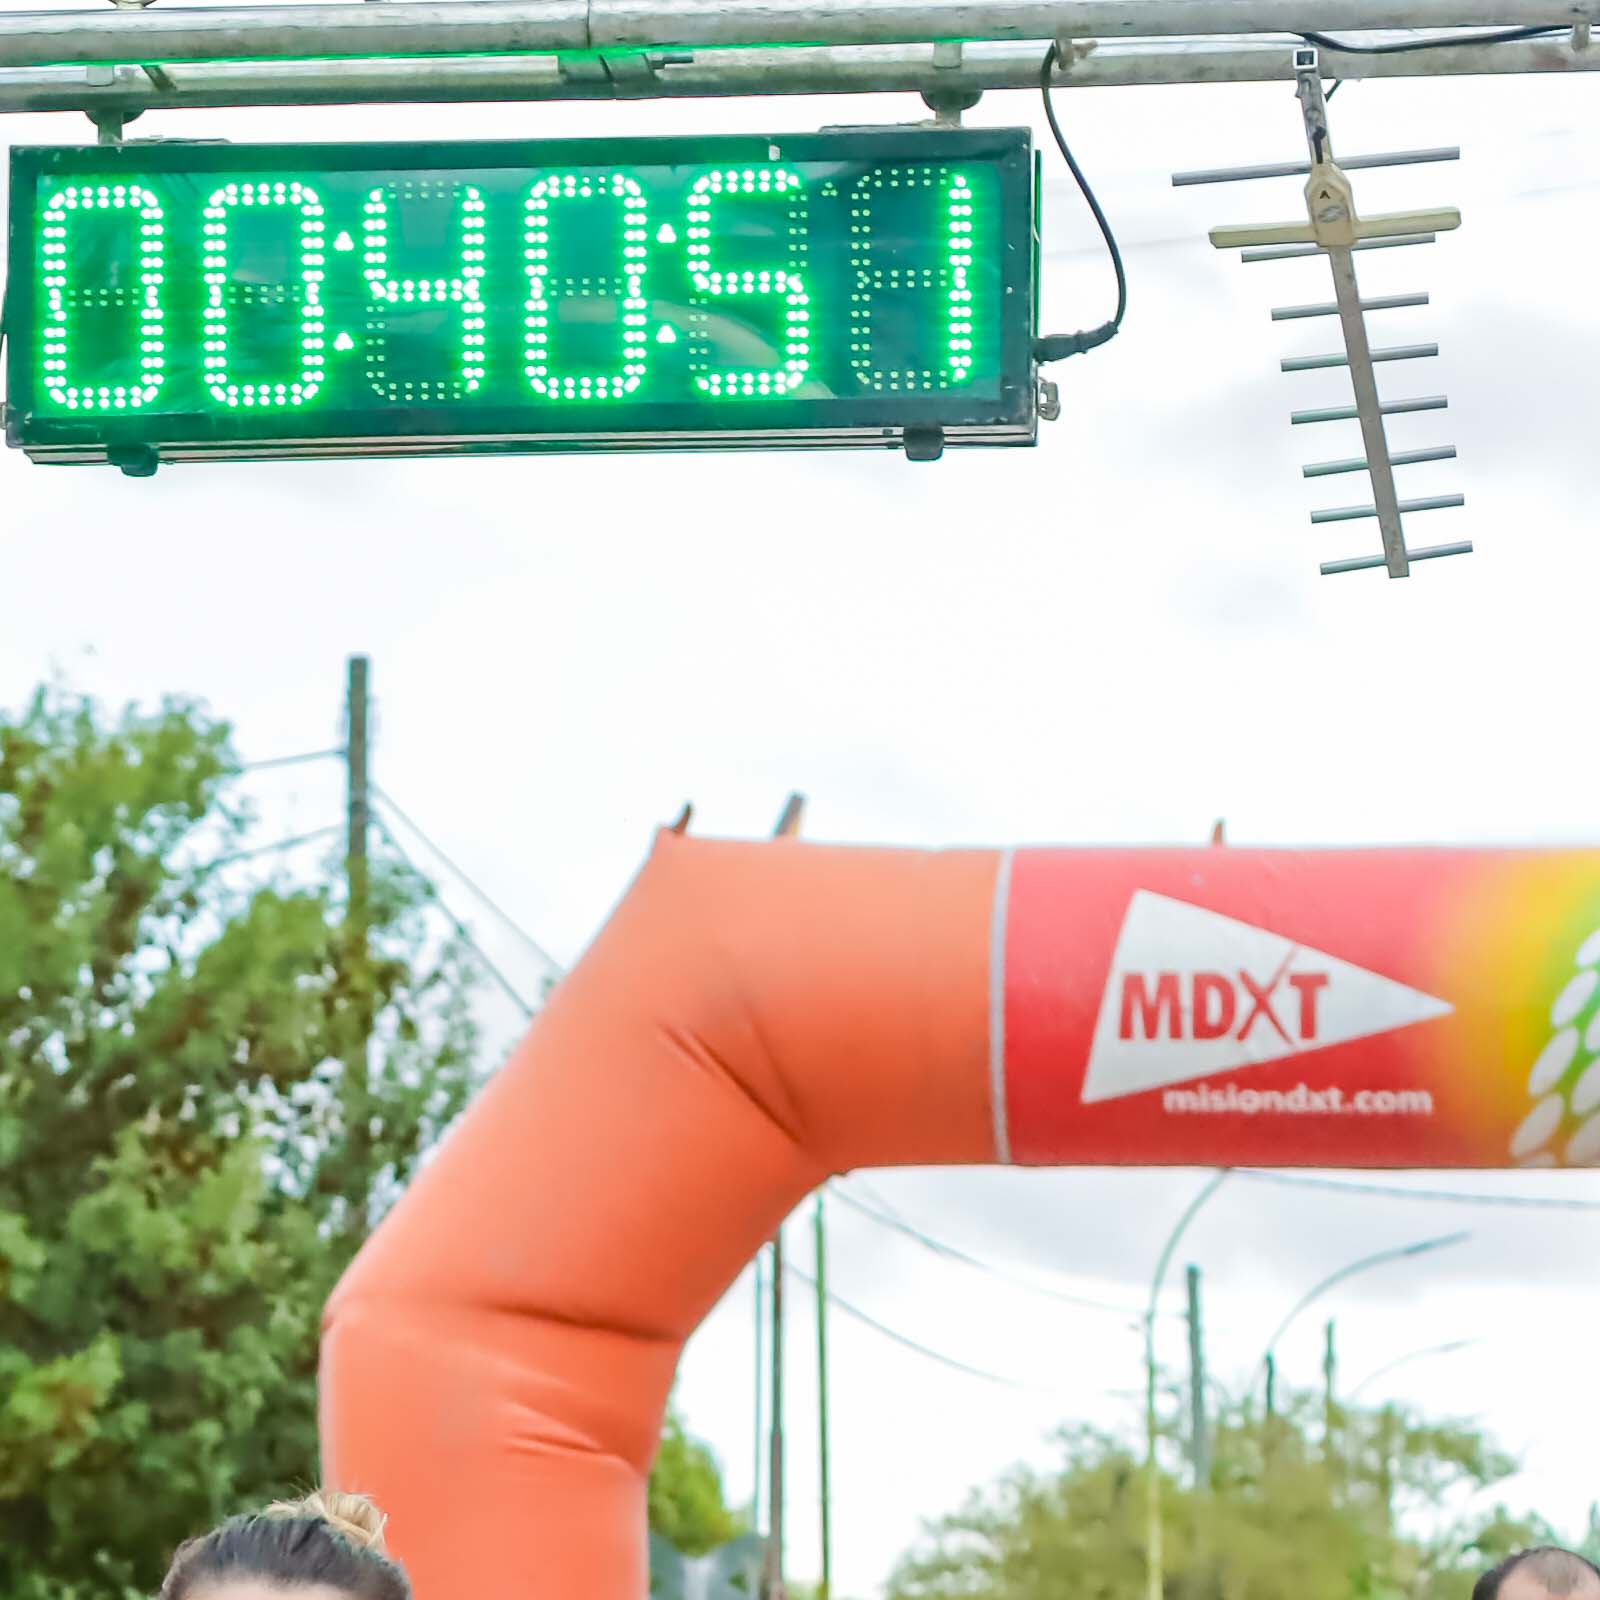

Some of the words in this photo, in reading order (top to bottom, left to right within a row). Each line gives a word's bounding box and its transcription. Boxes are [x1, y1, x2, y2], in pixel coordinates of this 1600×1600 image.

[40, 166, 972, 410] 00:40:51
[1118, 948, 1329, 1045] MDXT
[1163, 1083, 1433, 1115] misiondxt.com
